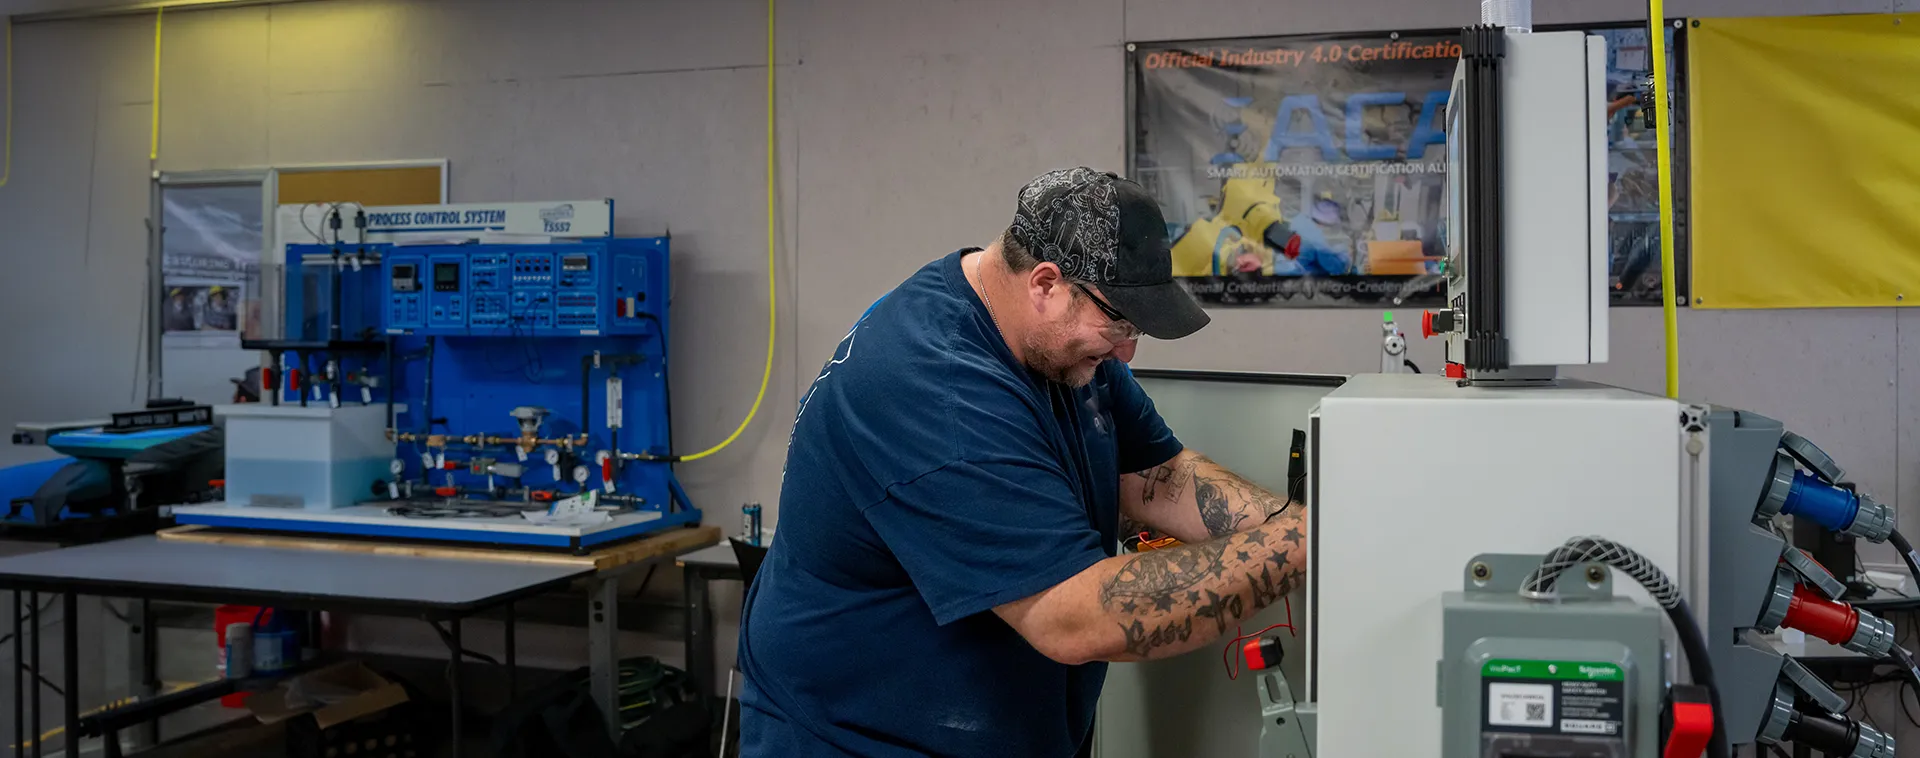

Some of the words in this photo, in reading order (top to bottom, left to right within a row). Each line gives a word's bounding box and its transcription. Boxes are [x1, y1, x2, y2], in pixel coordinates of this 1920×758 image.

[1145, 51, 1213, 69] Official
[1219, 47, 1305, 67] Industry
[1311, 45, 1342, 63] 4.0
[1347, 40, 1462, 62] Certificatio
[1206, 167, 1247, 180] SMART
[1250, 165, 1334, 179] AUTOMATION
[1336, 163, 1425, 178] CERTIFICATION
[367, 212, 413, 227] PROCESS
[414, 210, 460, 225] CONTROL
[463, 208, 506, 224] SYSTEM
